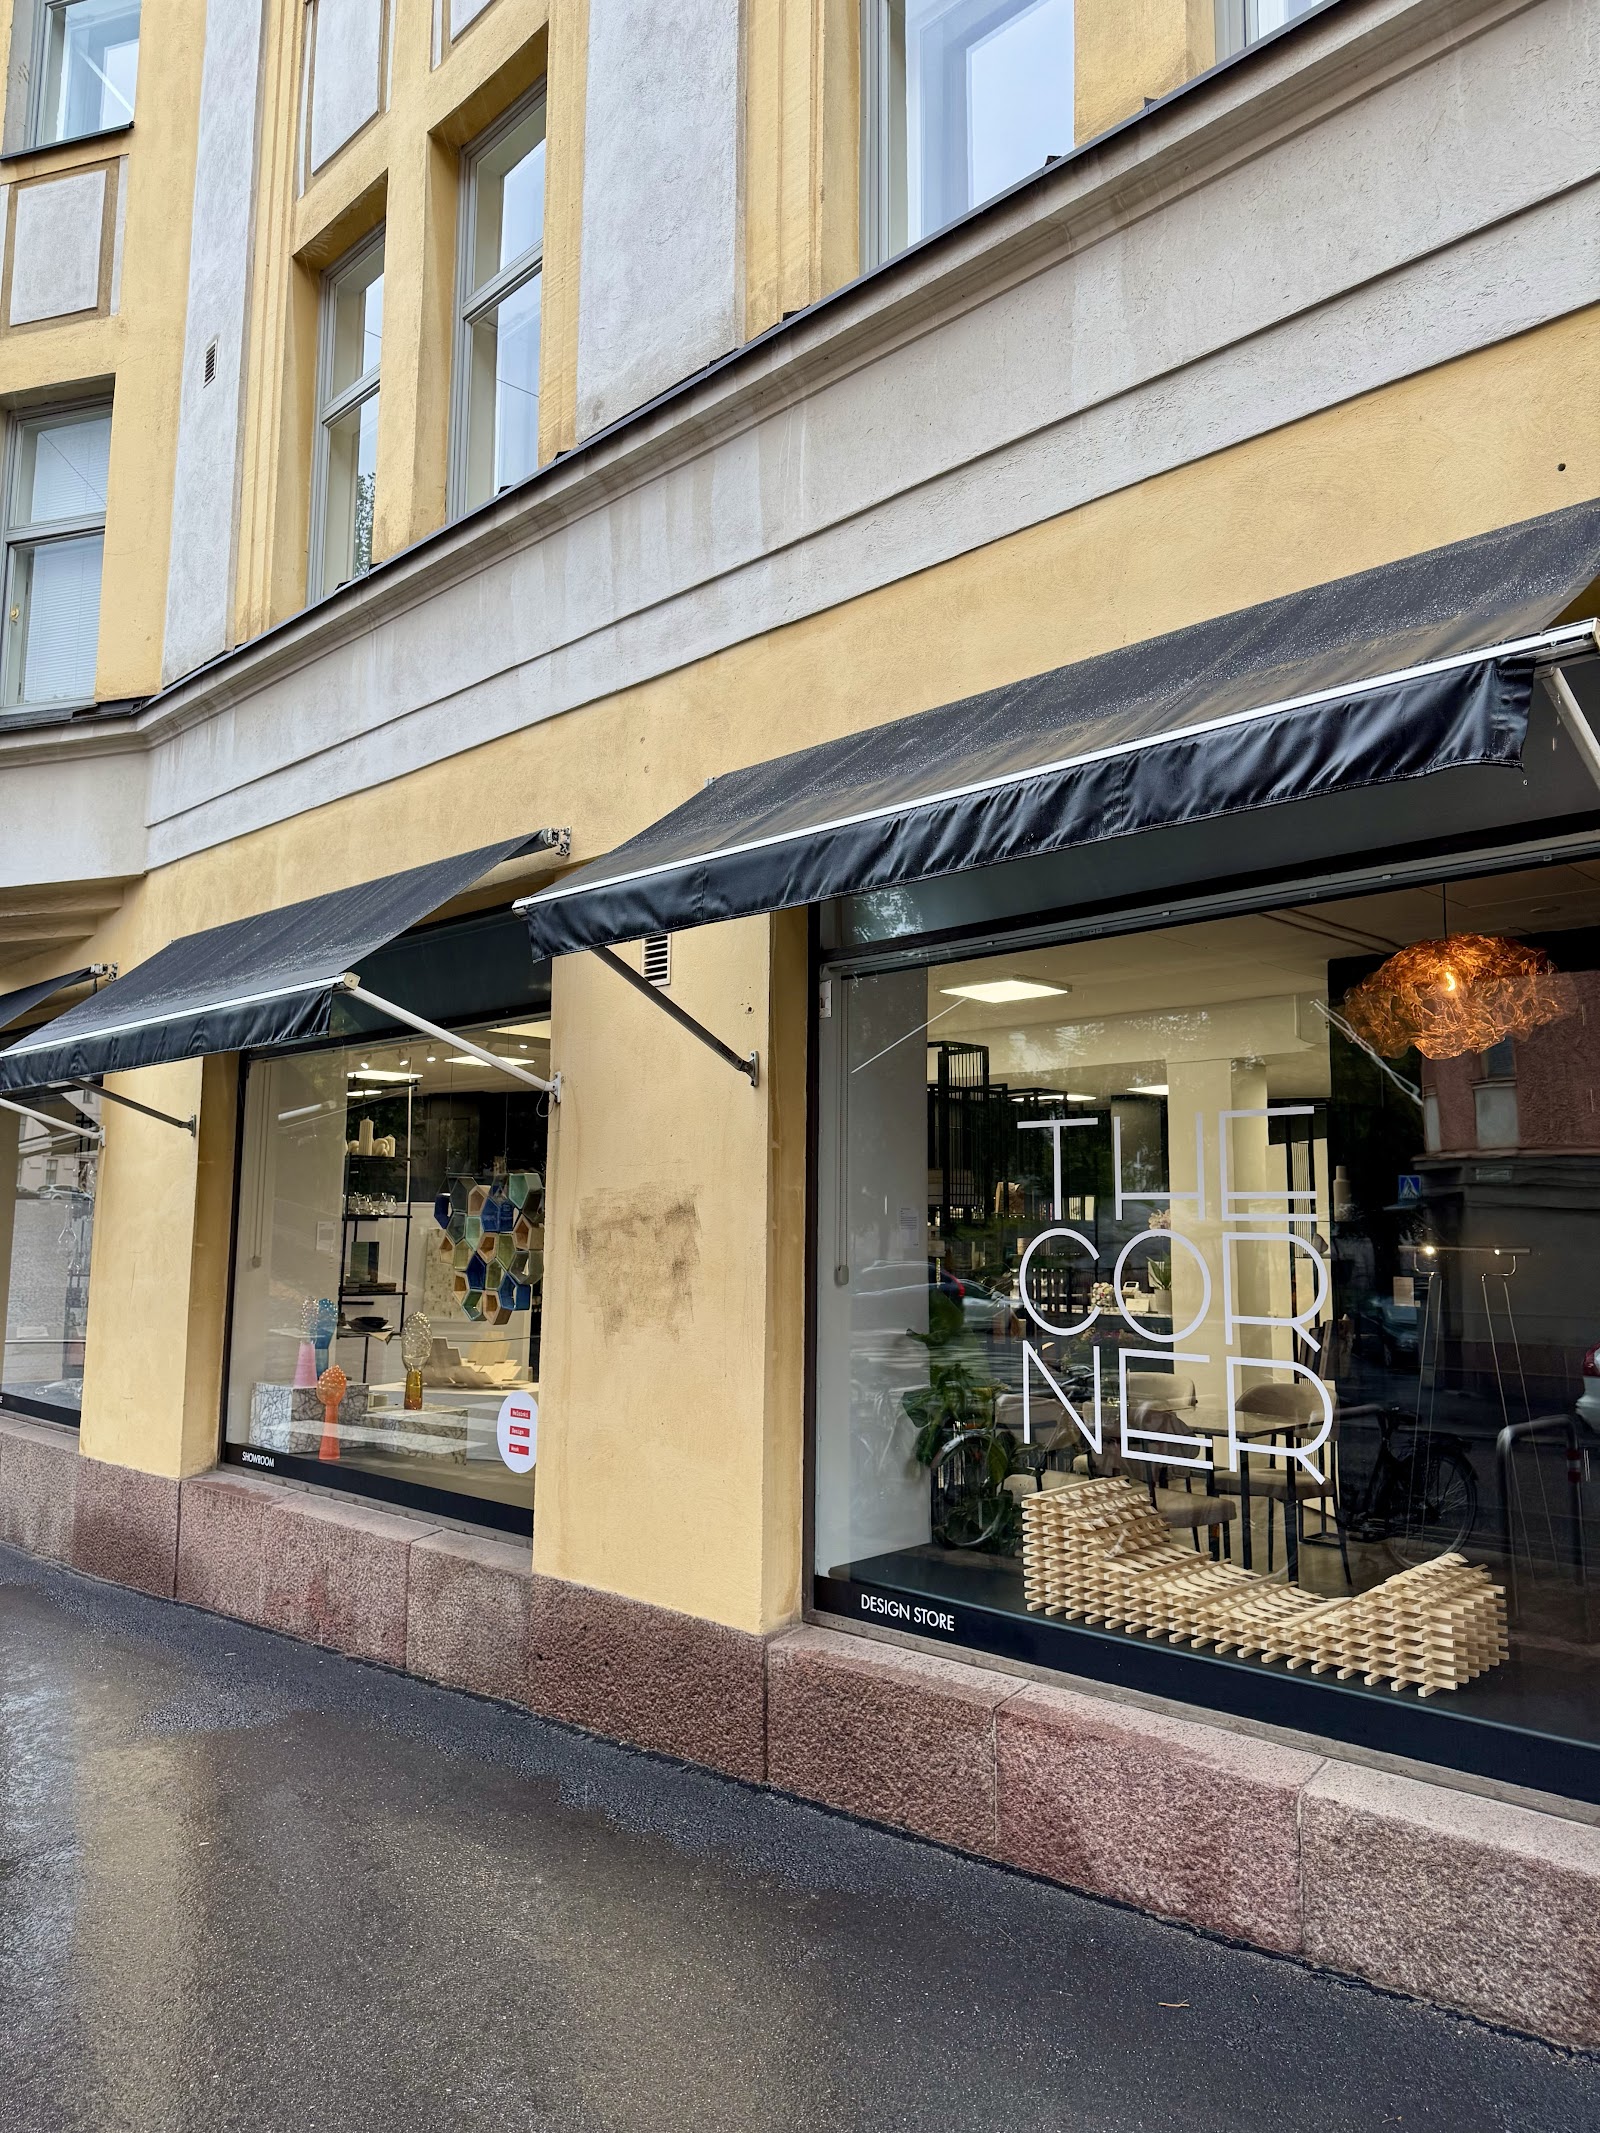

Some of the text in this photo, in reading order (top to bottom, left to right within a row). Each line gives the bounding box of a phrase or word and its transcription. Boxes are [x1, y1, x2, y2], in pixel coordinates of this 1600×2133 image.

[1017, 1106, 1318, 1221] THE
[1019, 1228, 1328, 1352] COR
[242, 1451, 275, 1467] SHOWROOM
[1022, 1340, 1333, 1485] NER
[861, 1593, 955, 1631] DESIGN STORE
